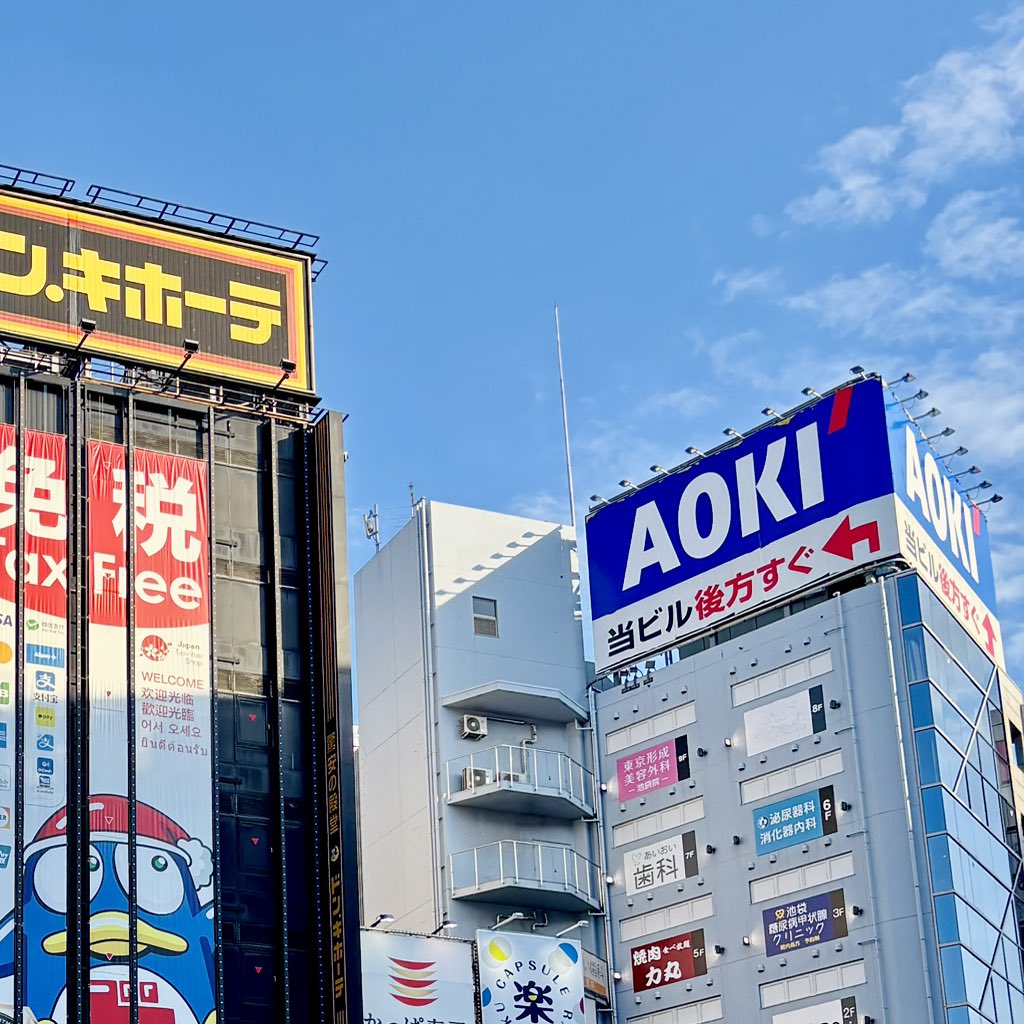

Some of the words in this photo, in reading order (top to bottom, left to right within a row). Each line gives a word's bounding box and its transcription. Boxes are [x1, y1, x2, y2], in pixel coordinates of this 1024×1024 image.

[622, 422, 826, 592] AOKI
[905, 424, 980, 585] AOKI
[93, 552, 204, 611] Free
[607, 545, 816, 659] 当ビル後方すぐ
[141, 671, 204, 690] WELCOME
[141, 687, 194, 706] 欢迎光临
[141, 702, 195, 722] 歡迎光臨
[812, 703, 823, 714] 8F
[141, 719, 164, 734] 어서
[168, 723, 202, 739] 오세요
[623, 746, 670, 772] 東京形成
[678, 753, 688, 763] 9F
[624, 761, 671, 786] 美容外科
[769, 800, 816, 825] 泌尿器科
[759, 817, 818, 845] 消化器内科
[685, 851, 695, 860] 7F
[633, 855, 679, 890] 歯科
[786, 901, 808, 918] 池袋
[833, 907, 845, 918] 3F
[773, 922, 825, 946] クリニック
[633, 945, 662, 967] 焼肉
[693, 948, 705, 958] 5F
[496, 960, 570, 996] CAPSULE
[514, 980, 555, 1024] 楽
[843, 1007, 855, 1019] 2F
